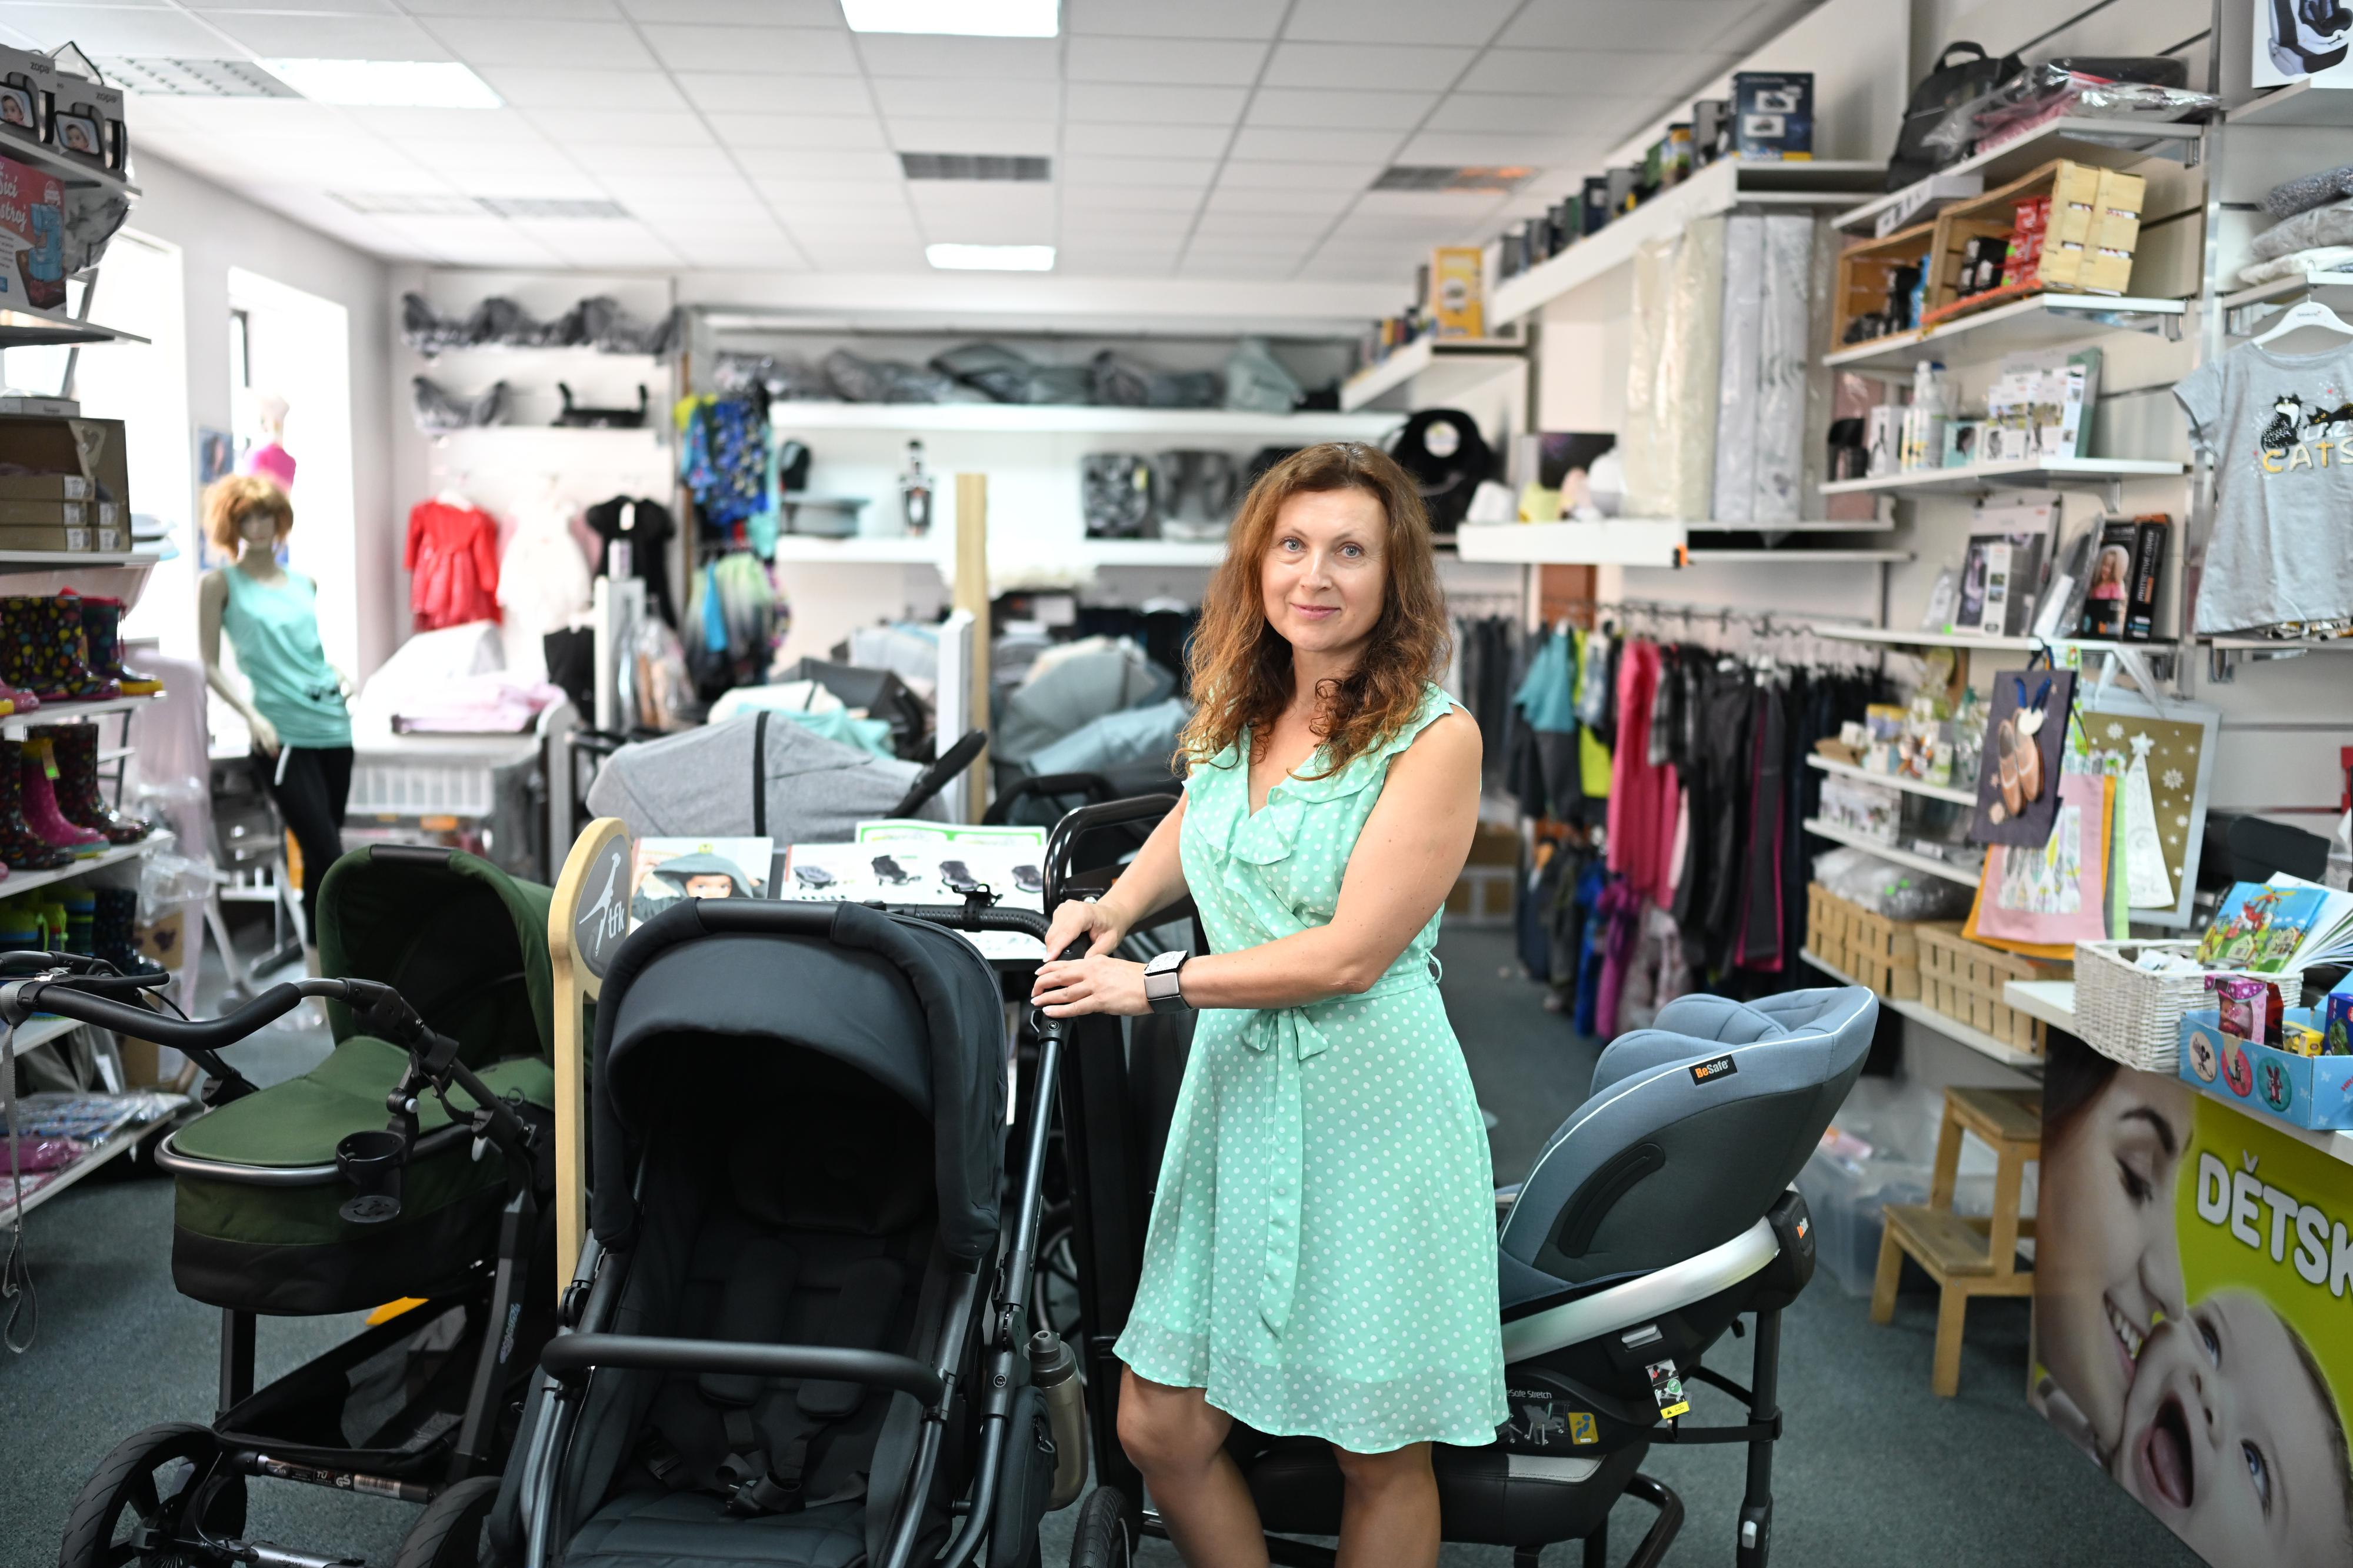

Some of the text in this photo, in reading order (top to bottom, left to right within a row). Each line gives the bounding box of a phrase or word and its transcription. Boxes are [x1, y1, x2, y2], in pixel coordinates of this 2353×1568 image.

[30, 62, 50, 74] zopa
[2304, 419, 2353, 442] LAZ
[2262, 436, 2353, 473] CATS
[608, 900, 624, 939] tfk
[1695, 1060, 1728, 1079] BeSafe
[1507, 1389, 1552, 1399] eSafe Stretch
[336, 1474, 351, 1487] GS
